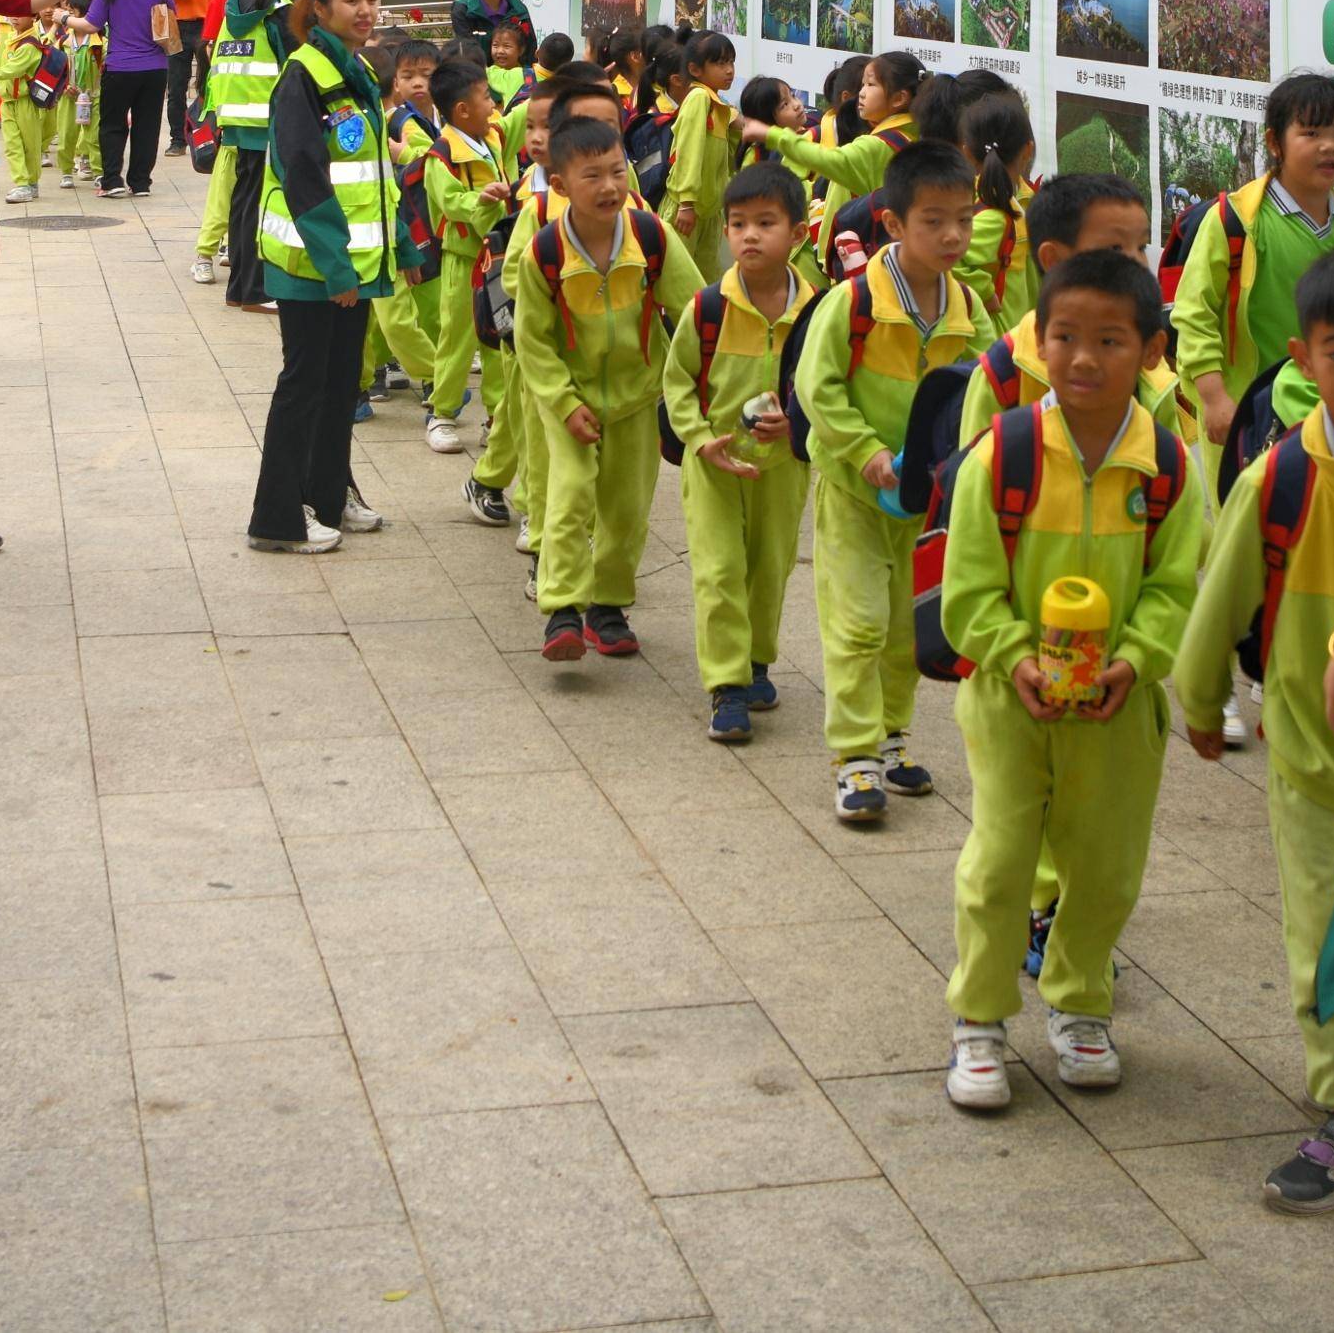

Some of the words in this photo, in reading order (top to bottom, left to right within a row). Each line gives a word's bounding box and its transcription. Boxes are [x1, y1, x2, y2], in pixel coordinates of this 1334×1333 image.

[1076, 68, 1127, 91] 城乡一体绿美提升
